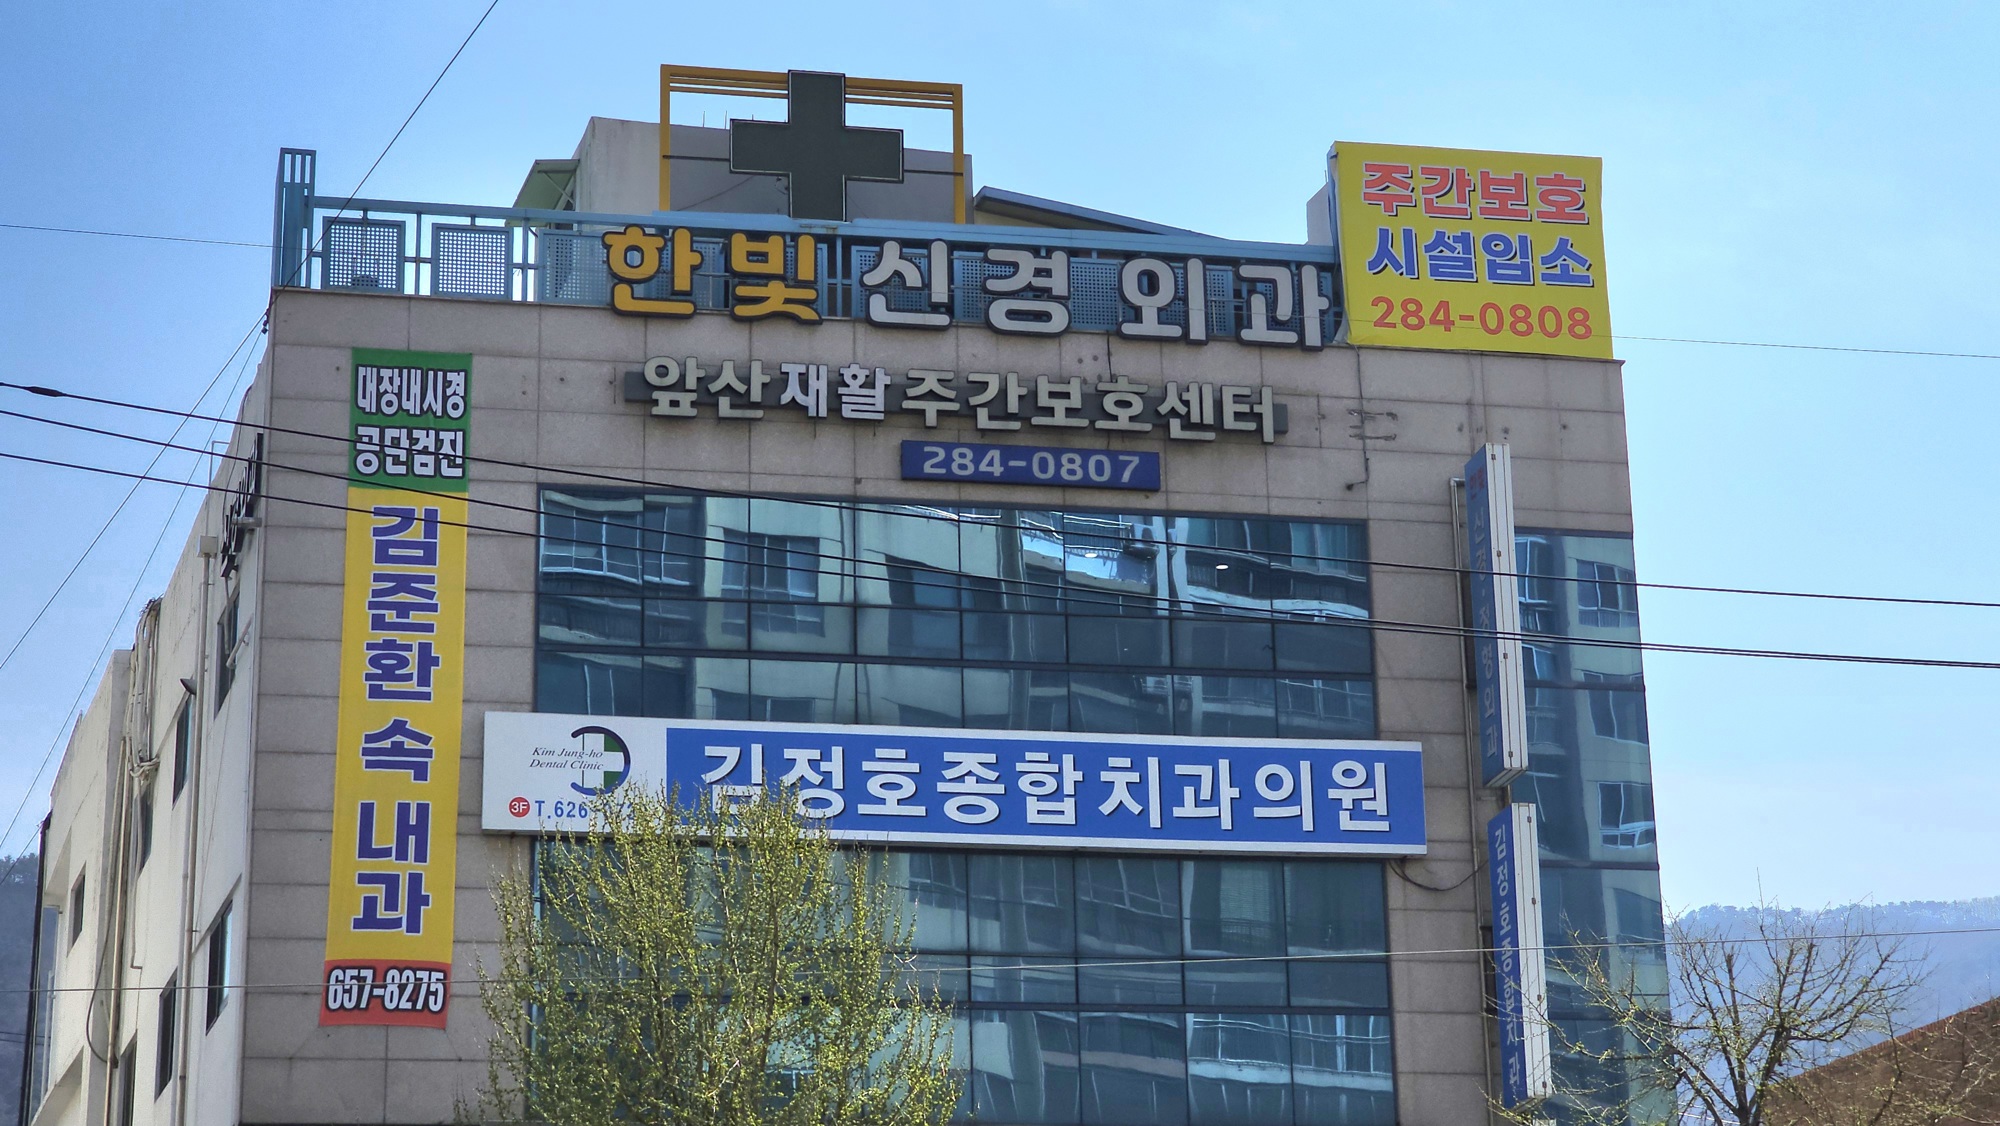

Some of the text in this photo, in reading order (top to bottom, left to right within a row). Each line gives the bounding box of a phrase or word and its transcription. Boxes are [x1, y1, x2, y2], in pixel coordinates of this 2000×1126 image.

[1361, 162, 1589, 224] 주간보호
[602, 225, 822, 323] 한빛
[1366, 227, 1594, 287] 시설입소
[1371, 296, 1593, 340] 284-0808
[356, 365, 466, 419] 대장내시경
[355, 425, 464, 477] 공단검진
[923, 446, 1140, 483] 284-0807
[529, 759, 604, 770] Dental Clinic
[532, 747, 603, 759] Kim Jung-ho
[511, 801, 528, 813] 3F
[327, 967, 446, 1012] 657-8275
